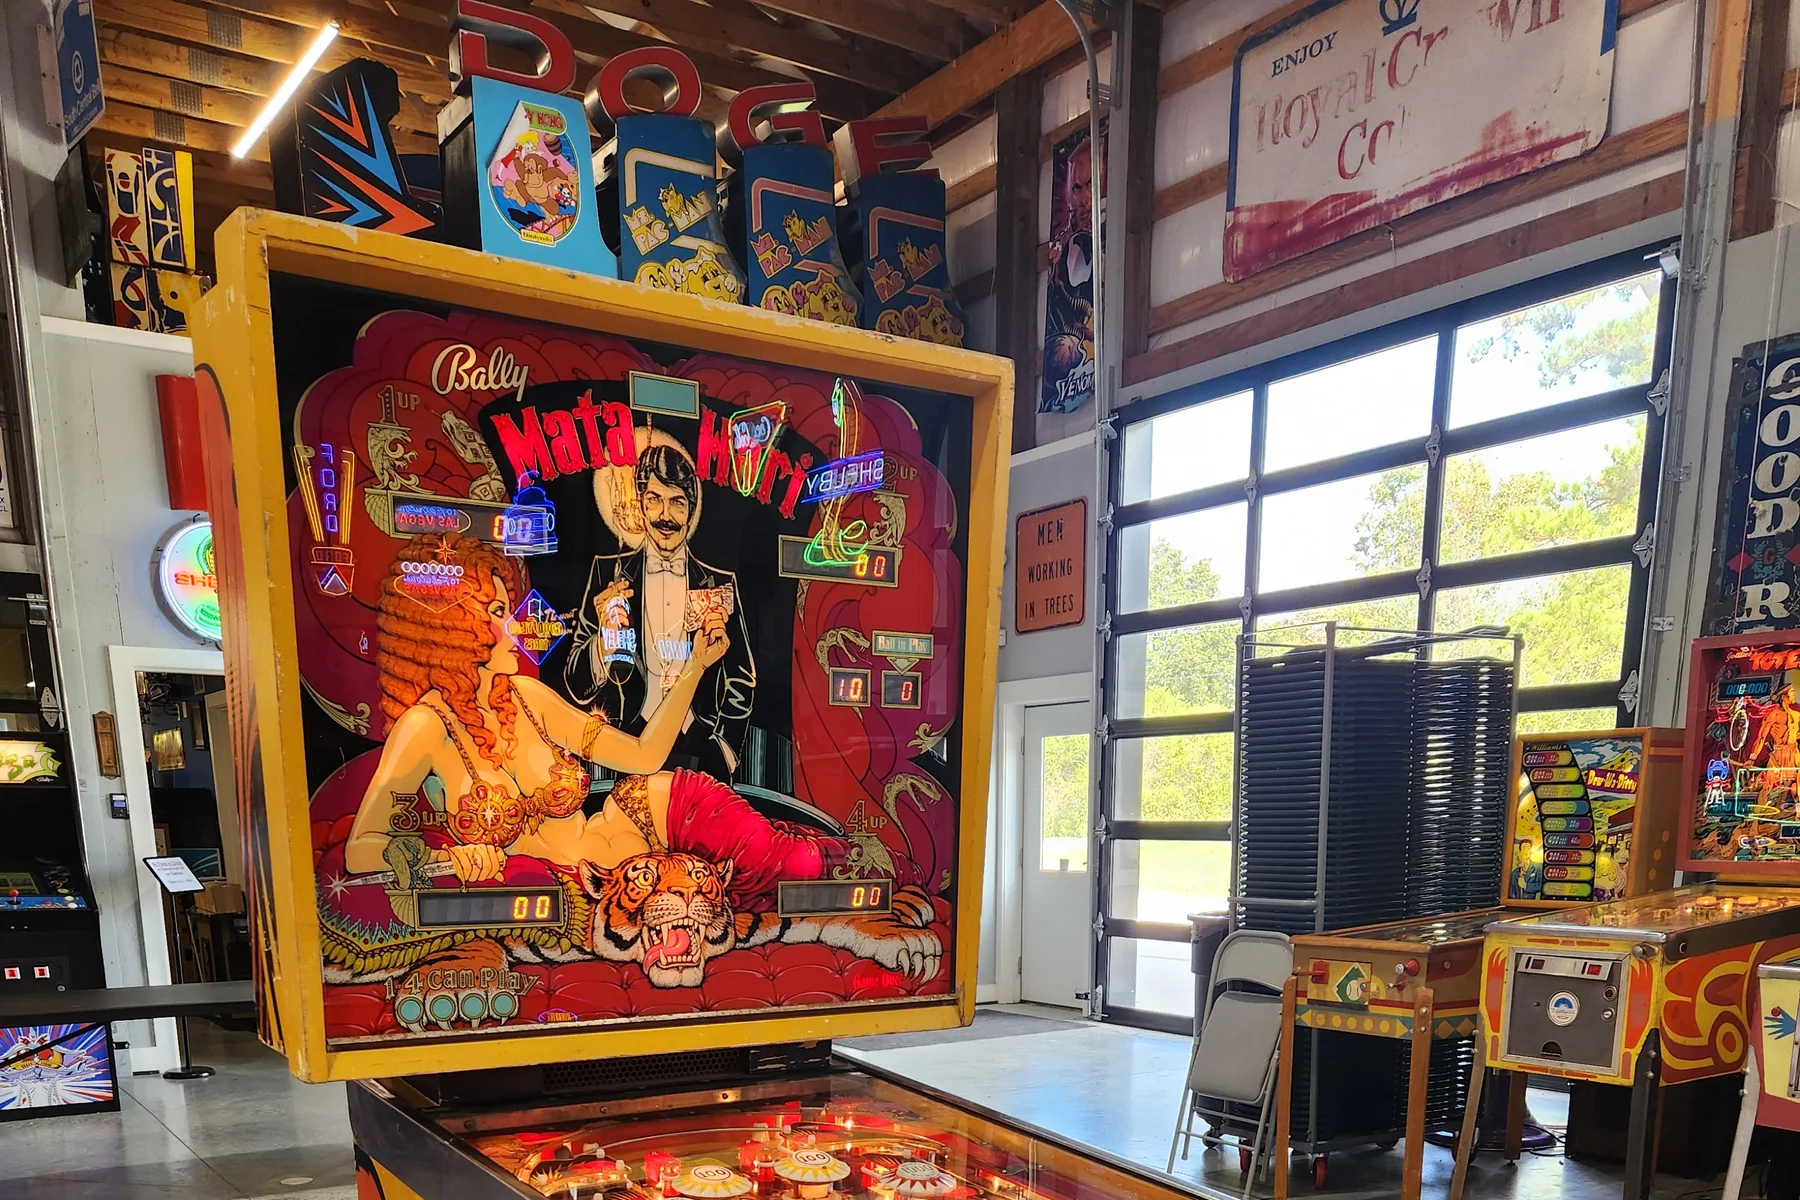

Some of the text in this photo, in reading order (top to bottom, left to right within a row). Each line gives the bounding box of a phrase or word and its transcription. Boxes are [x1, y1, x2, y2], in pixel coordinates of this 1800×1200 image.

[1271, 31, 1338, 78] ENJOY
[537, 112, 564, 130] KONG
[523, 231, 553, 244] Nintendo
[431, 343, 529, 402] Bally
[1060, 371, 1096, 402] VENOM
[397, 391, 421, 411] UP
[490, 388, 814, 520] Mata Hari
[900, 467, 918, 480] UP
[1037, 517, 1064, 546] MEN
[1028, 557, 1073, 583] WORKING
[1025, 594, 1074, 620] IN TREES
[878, 635, 895, 650] Ball
[909, 637, 928, 652] Play
[1749, 649, 1800, 671] TOTE
[838, 677, 863, 699] 10
[901, 681, 913, 701] 0
[390, 790, 448, 831] 3 UP
[845, 800, 888, 833] 4 UP
[513, 896, 551, 920] 00
[852, 887, 881, 907] 00
[427, 968, 475, 991] Can
[480, 966, 539, 997] Play
[799, 1153, 826, 1163] 100
[698, 1169, 727, 1178] 100
[901, 1165, 934, 1174] 1000
